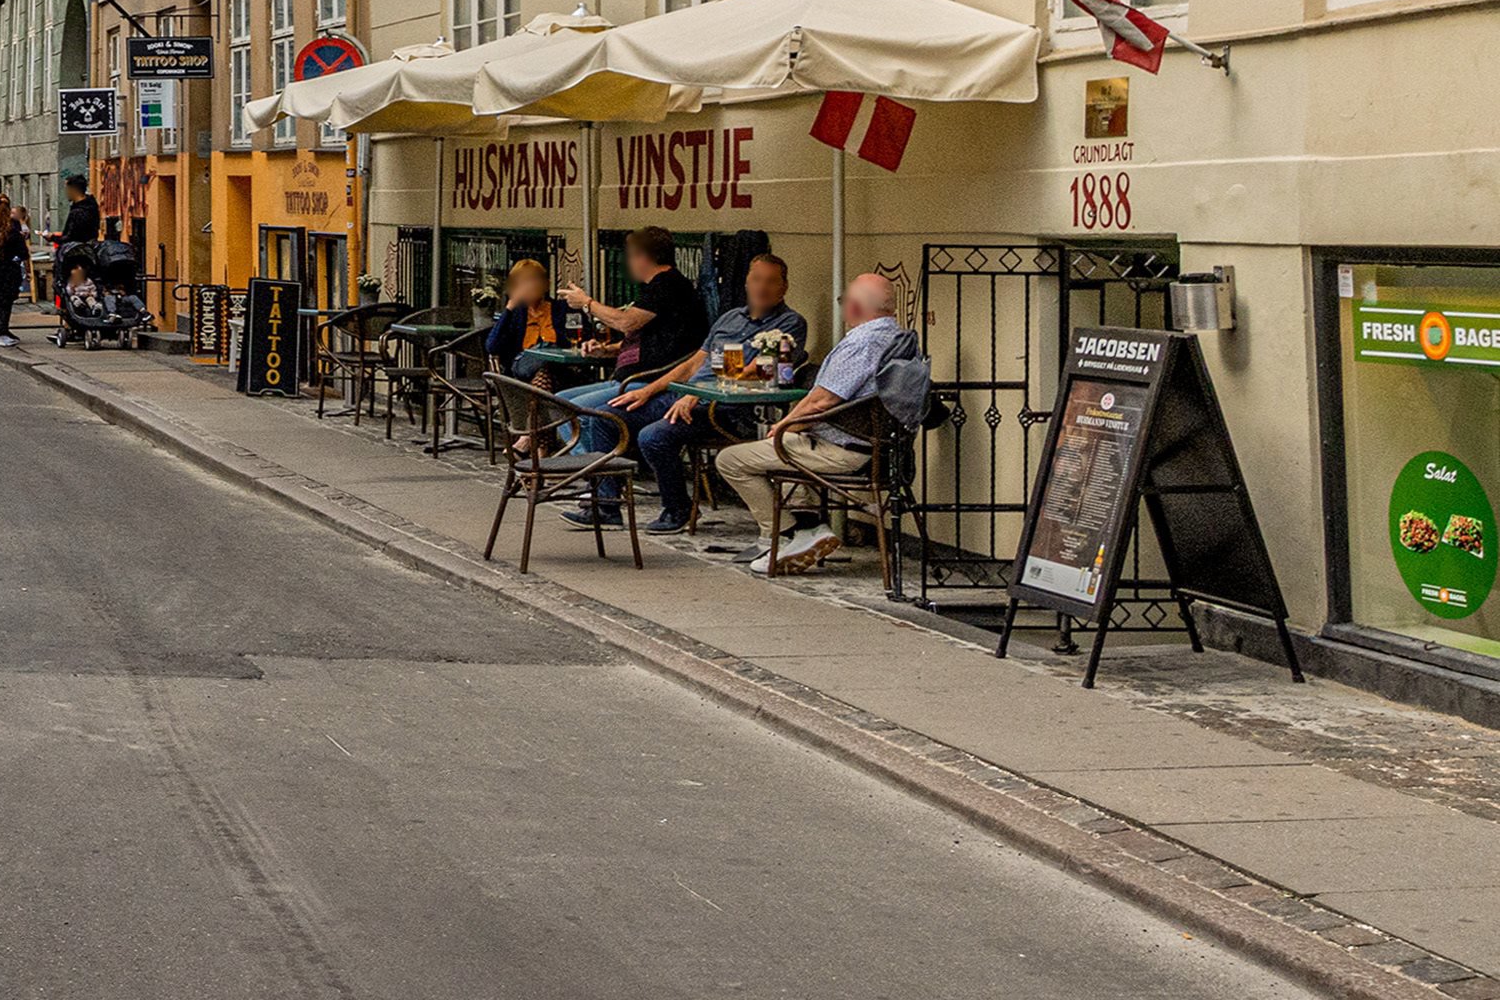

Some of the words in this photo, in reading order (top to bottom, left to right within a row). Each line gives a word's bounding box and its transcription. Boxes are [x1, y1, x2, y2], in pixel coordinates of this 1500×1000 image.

[133, 56, 177, 67] TATTOO
[179, 55, 208, 66] SHOP
[1074, 143, 1134, 164] GRUNDLAGT
[617, 127, 754, 211] VINSTUE
[285, 192, 310, 215] TATTOO
[312, 192, 328, 215] SHOP
[266, 286, 283, 385] TATTOO
[1362, 322, 1415, 342] FRESH
[1075, 337, 1160, 361] JACOBSEN
[1424, 463, 1457, 483] Salat
